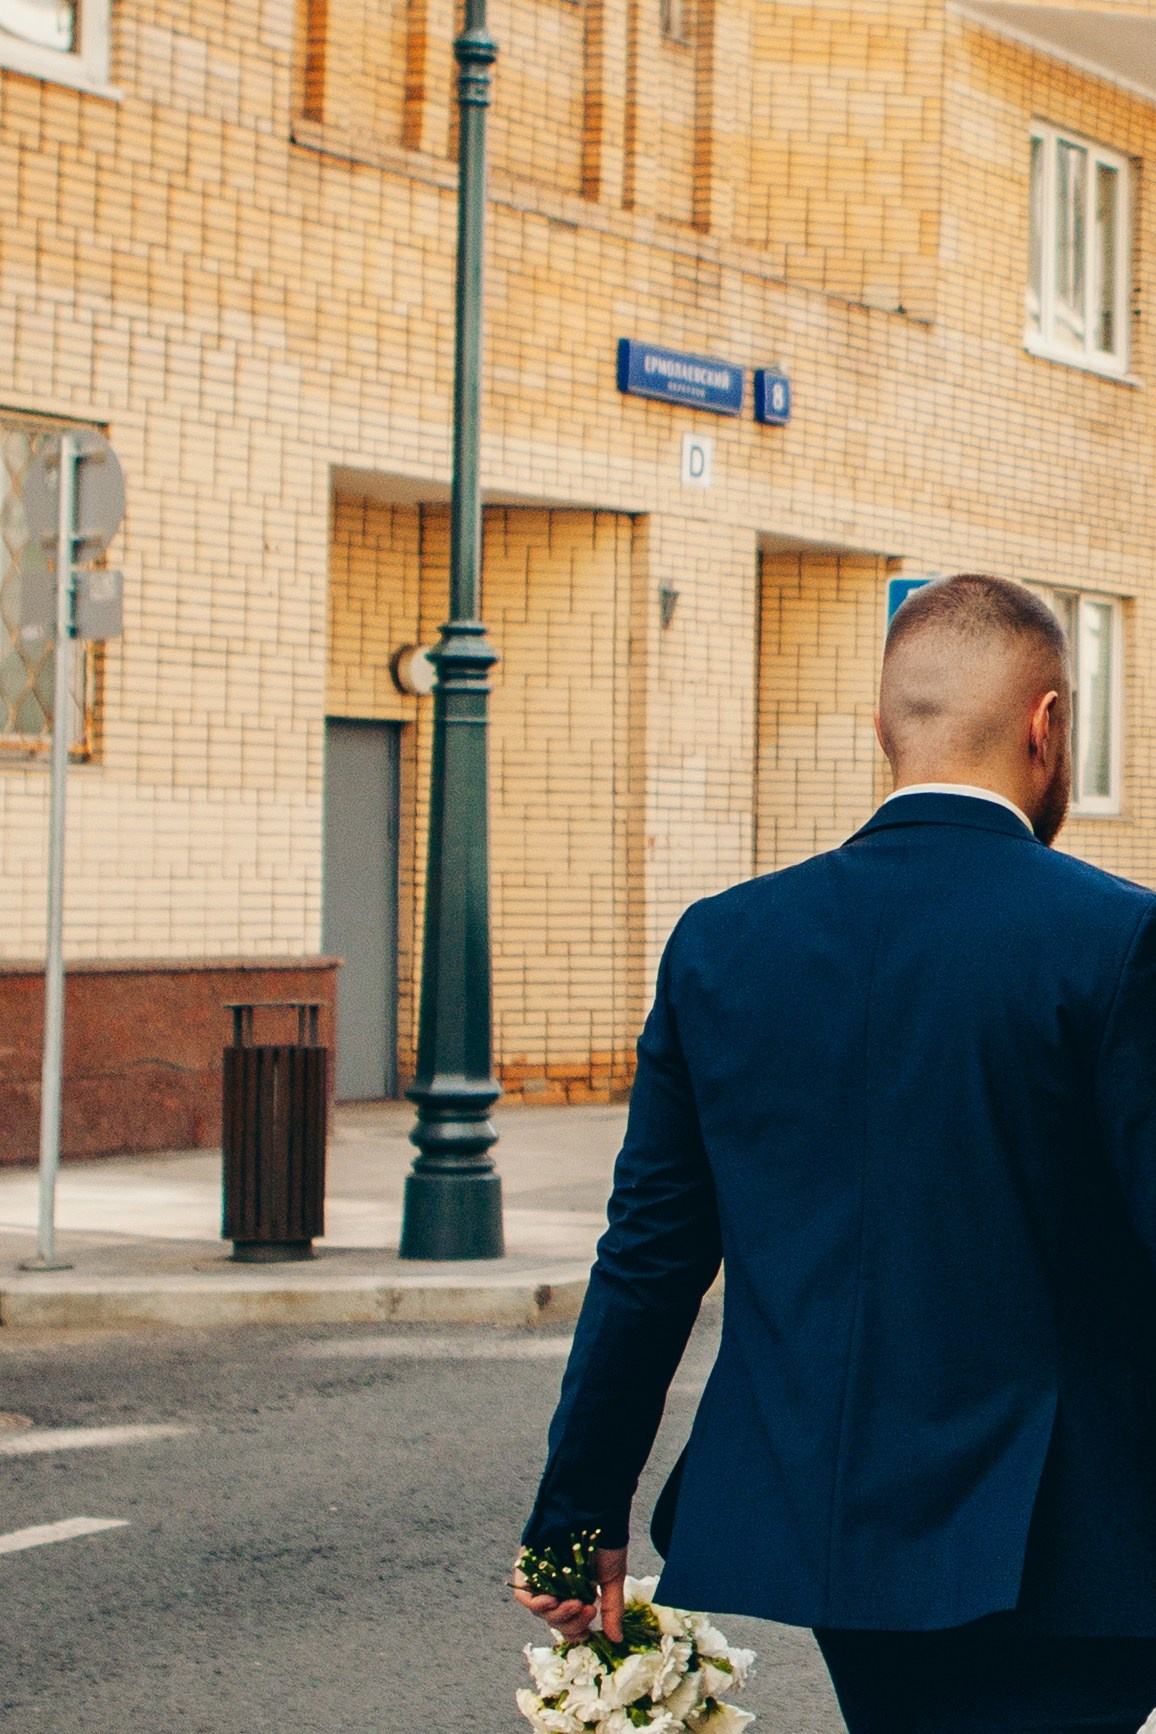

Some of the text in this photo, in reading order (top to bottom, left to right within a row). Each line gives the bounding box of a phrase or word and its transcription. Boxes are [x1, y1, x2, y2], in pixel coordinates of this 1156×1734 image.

[644, 354, 730, 389] ЕРМОЛАЕВСКИЙ
[772, 383, 784, 411] 8
[689, 445, 705, 478] D
